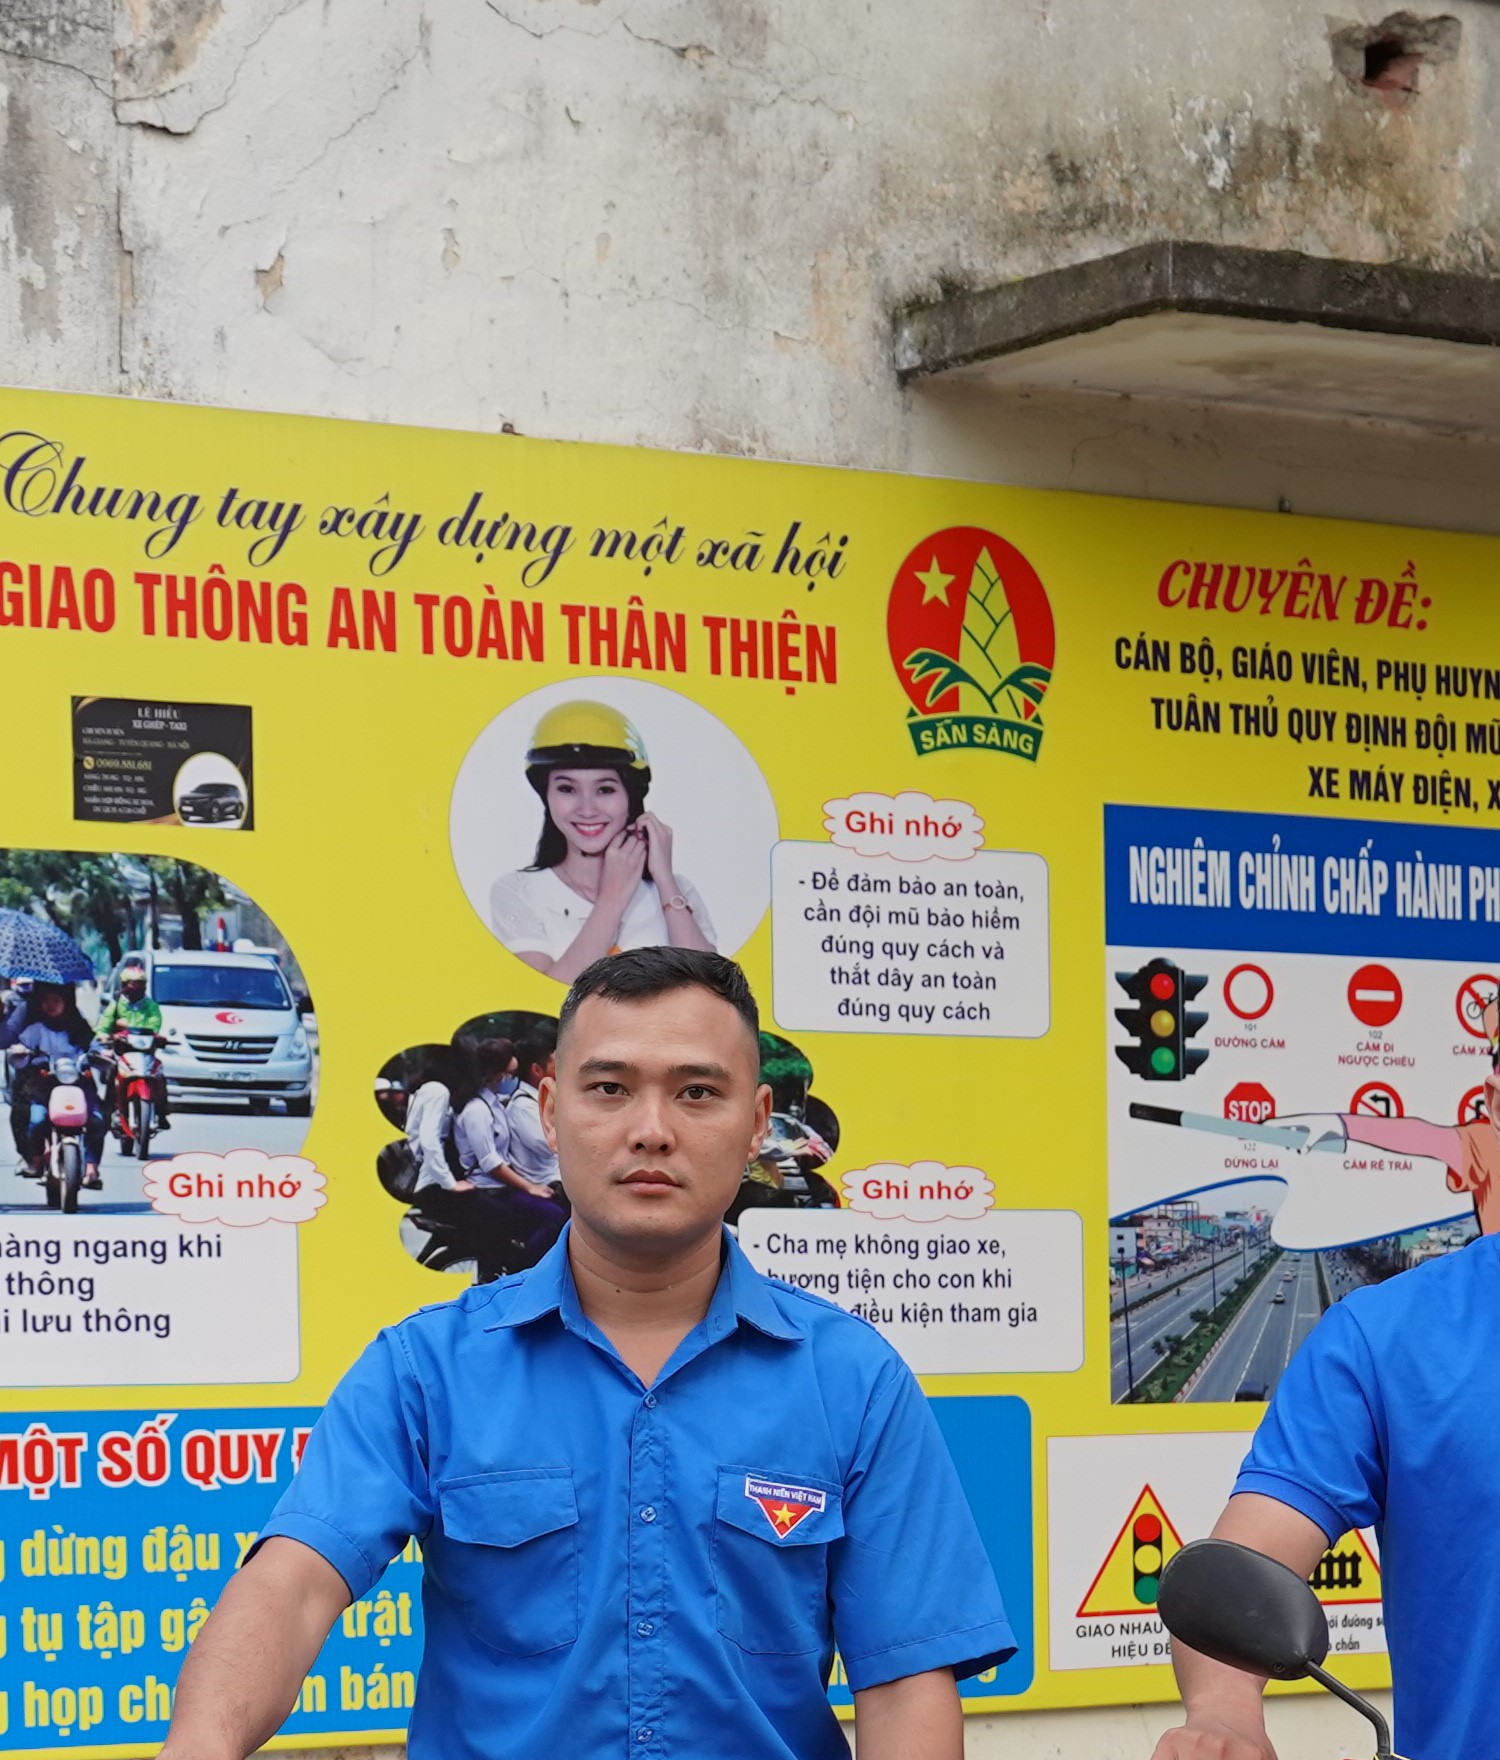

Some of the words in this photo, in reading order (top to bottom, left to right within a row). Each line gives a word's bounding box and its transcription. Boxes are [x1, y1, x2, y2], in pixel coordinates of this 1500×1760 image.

[216, 487, 306, 568] tay
[319, 491, 426, 577] xây
[438, 491, 576, 588] dựng
[590, 515, 686, 577] một
[697, 529, 766, 572] xã
[772, 521, 850, 592] hội
[1157, 556, 1348, 621] CHUYÊN
[1354, 559, 1433, 631] ĐỀ:
[133, 564, 309, 647] THÔNG
[327, 586, 397, 653] AN
[414, 583, 544, 663] TOÀN
[561, 594, 687, 673] THÂN
[702, 609, 838, 696] THIỆN
[1115, 632, 1170, 672] CÁN
[1180, 636, 1223, 683] BỘ,
[1232, 642, 1293, 682] GIÁO
[1301, 648, 1368, 693] VIÊN,
[1377, 659, 1426, 702] PHỤ
[920, 718, 967, 751] SẴN
[973, 722, 1034, 754] SÀNG
[845, 811, 894, 835] Ghi
[905, 815, 962, 838] nhớ
[812, 868, 839, 891] Để
[847, 873, 891, 893] đảm
[899, 876, 936, 895] bảo
[944, 882, 967, 897] an
[974, 880, 1025, 903] toàn,
[1228, 1100, 1272, 1123] STOP
[99, 1413, 178, 1488] SỐ
[183, 1430, 284, 1488] QUY
